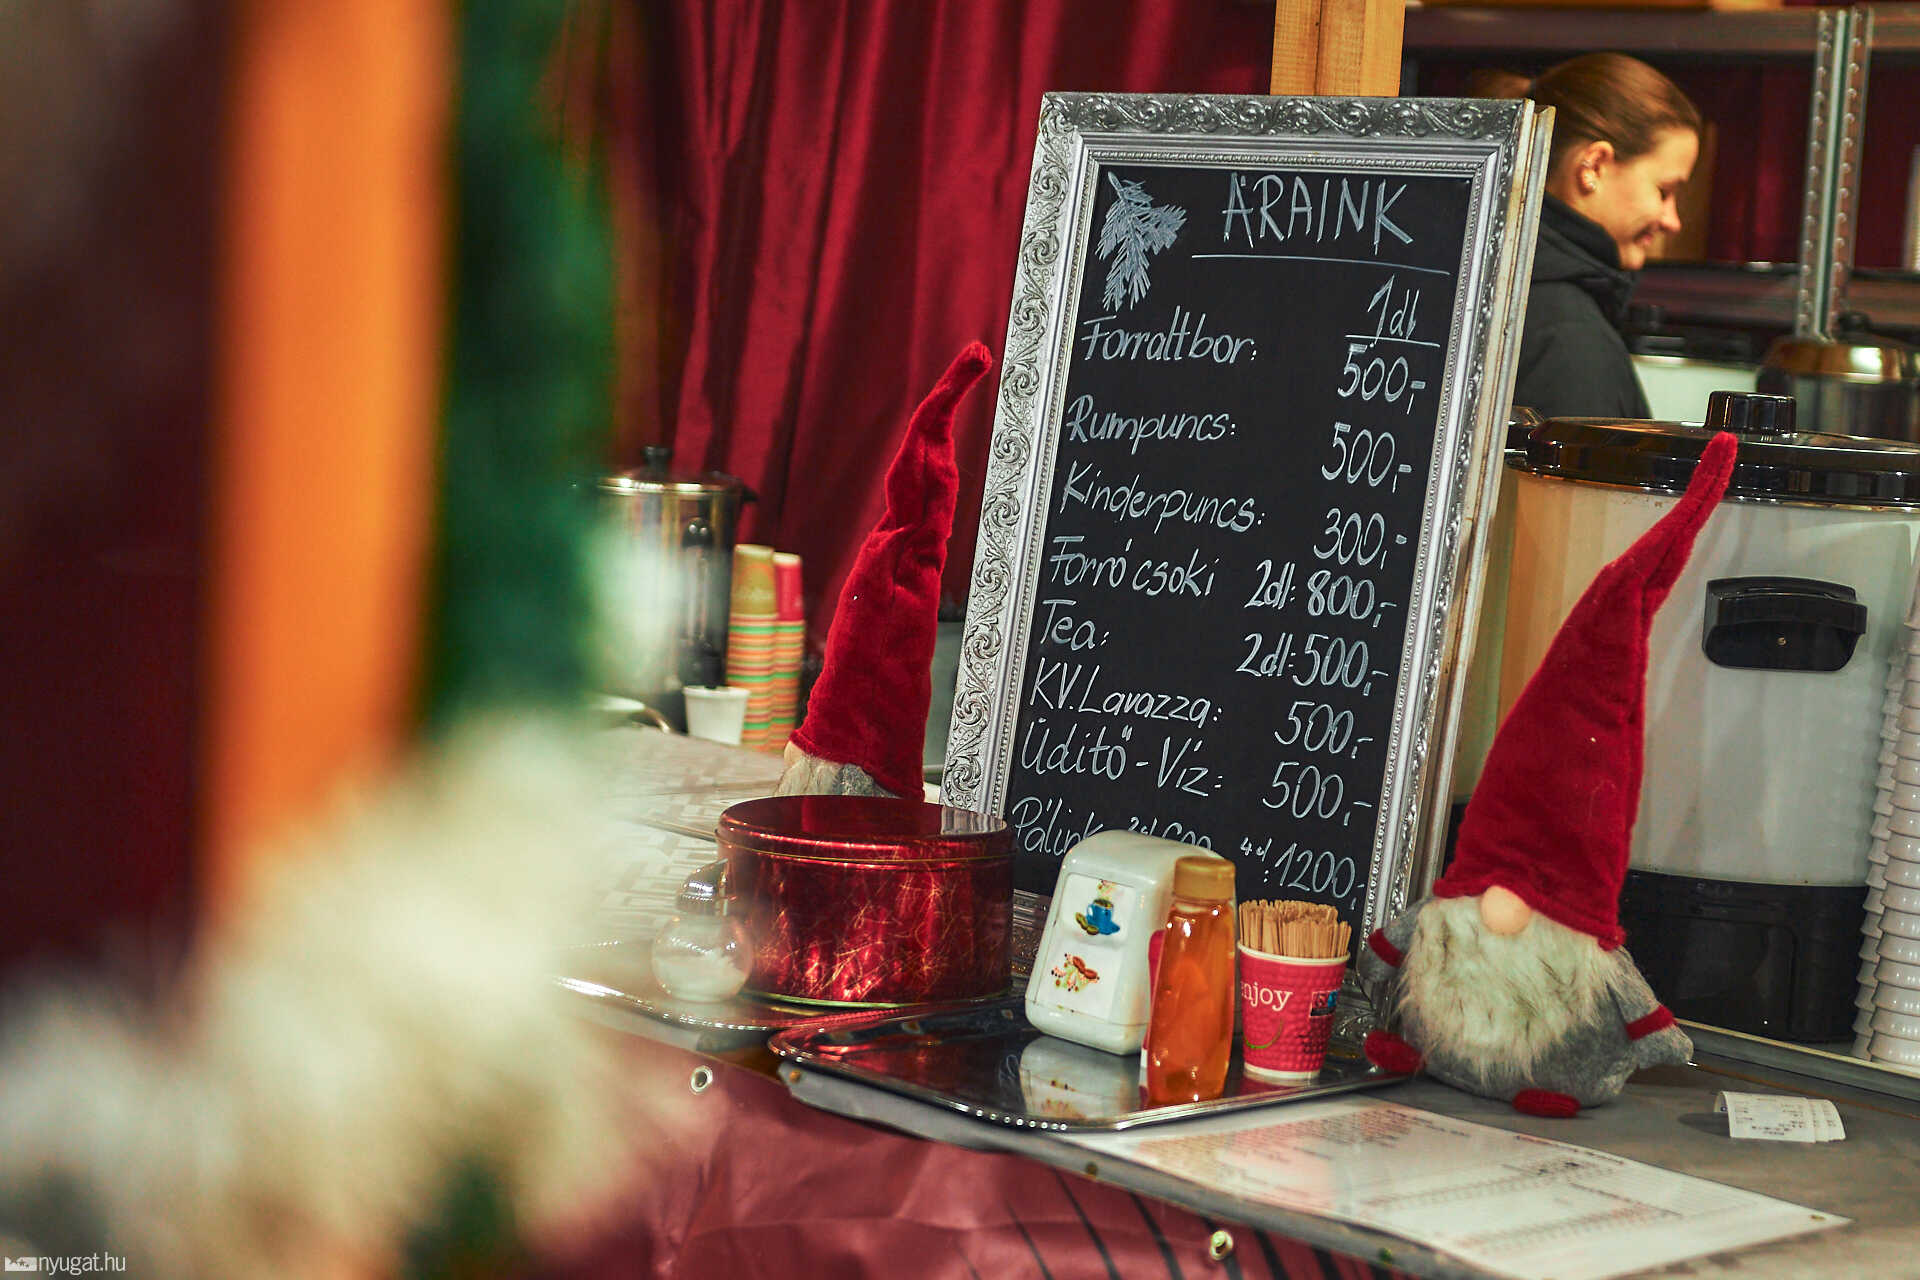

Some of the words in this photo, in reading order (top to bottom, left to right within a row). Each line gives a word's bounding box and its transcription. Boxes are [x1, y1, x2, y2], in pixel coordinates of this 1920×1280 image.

[1222, 172, 1414, 255] ÁRAINK
[1367, 274, 1421, 345] 1dl
[1066, 394, 1236, 455] Rumpuncs:
[1060, 459, 1266, 535] Kinderpuncs:
[1050, 535, 1132, 587] Forró
[1040, 598, 1110, 651] Tea:
[1241, 981, 1293, 1012] njoy
